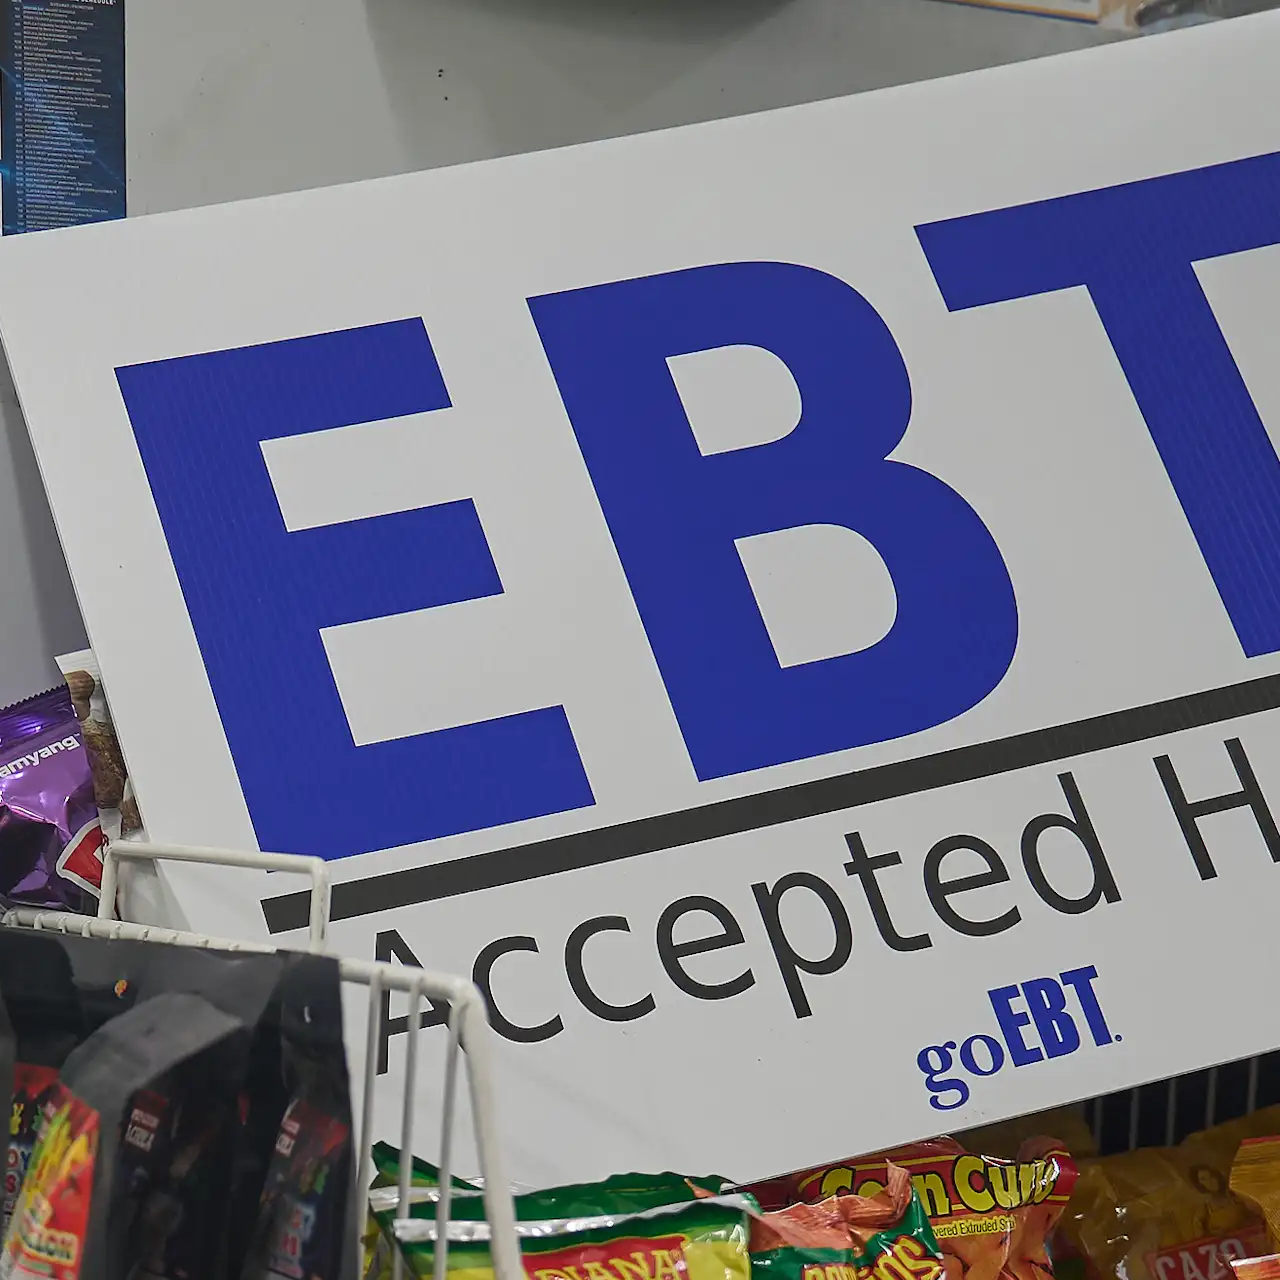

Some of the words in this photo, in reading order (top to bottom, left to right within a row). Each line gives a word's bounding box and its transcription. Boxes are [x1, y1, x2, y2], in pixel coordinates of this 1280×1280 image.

[113, 152, 1280, 872] EBT
[375, 771, 1123, 1075] Accepted
[959, 1218, 998, 1235] Extruded
